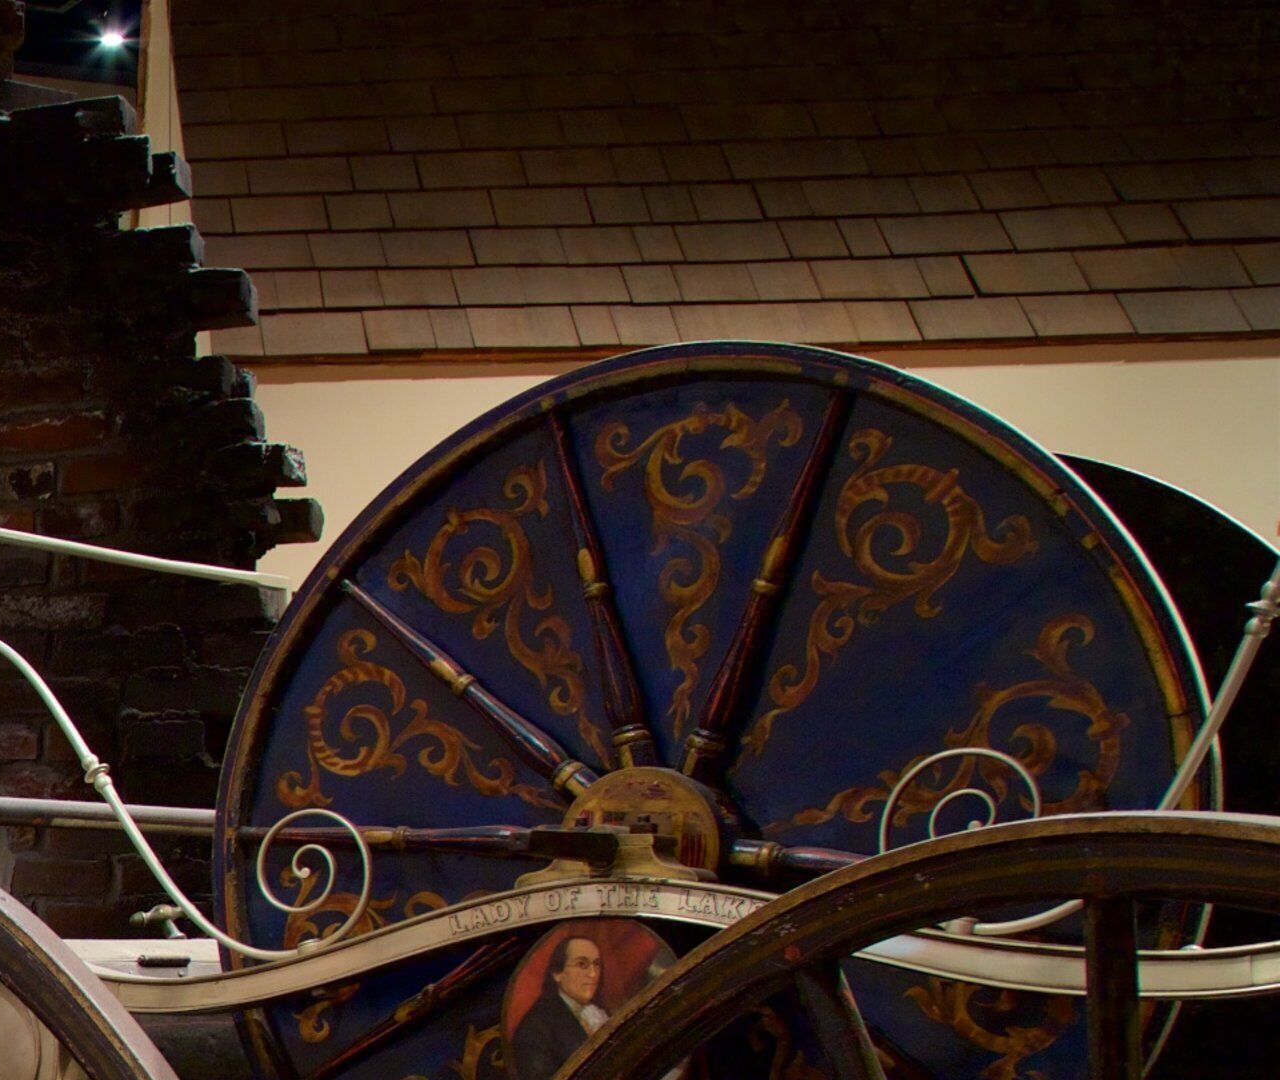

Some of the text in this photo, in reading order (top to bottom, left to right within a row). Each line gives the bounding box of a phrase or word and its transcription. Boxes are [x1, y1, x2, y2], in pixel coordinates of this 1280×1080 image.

[448, 894, 531, 935] LADY
[544, 886, 583, 912] OF
[596, 885, 661, 909] THE
